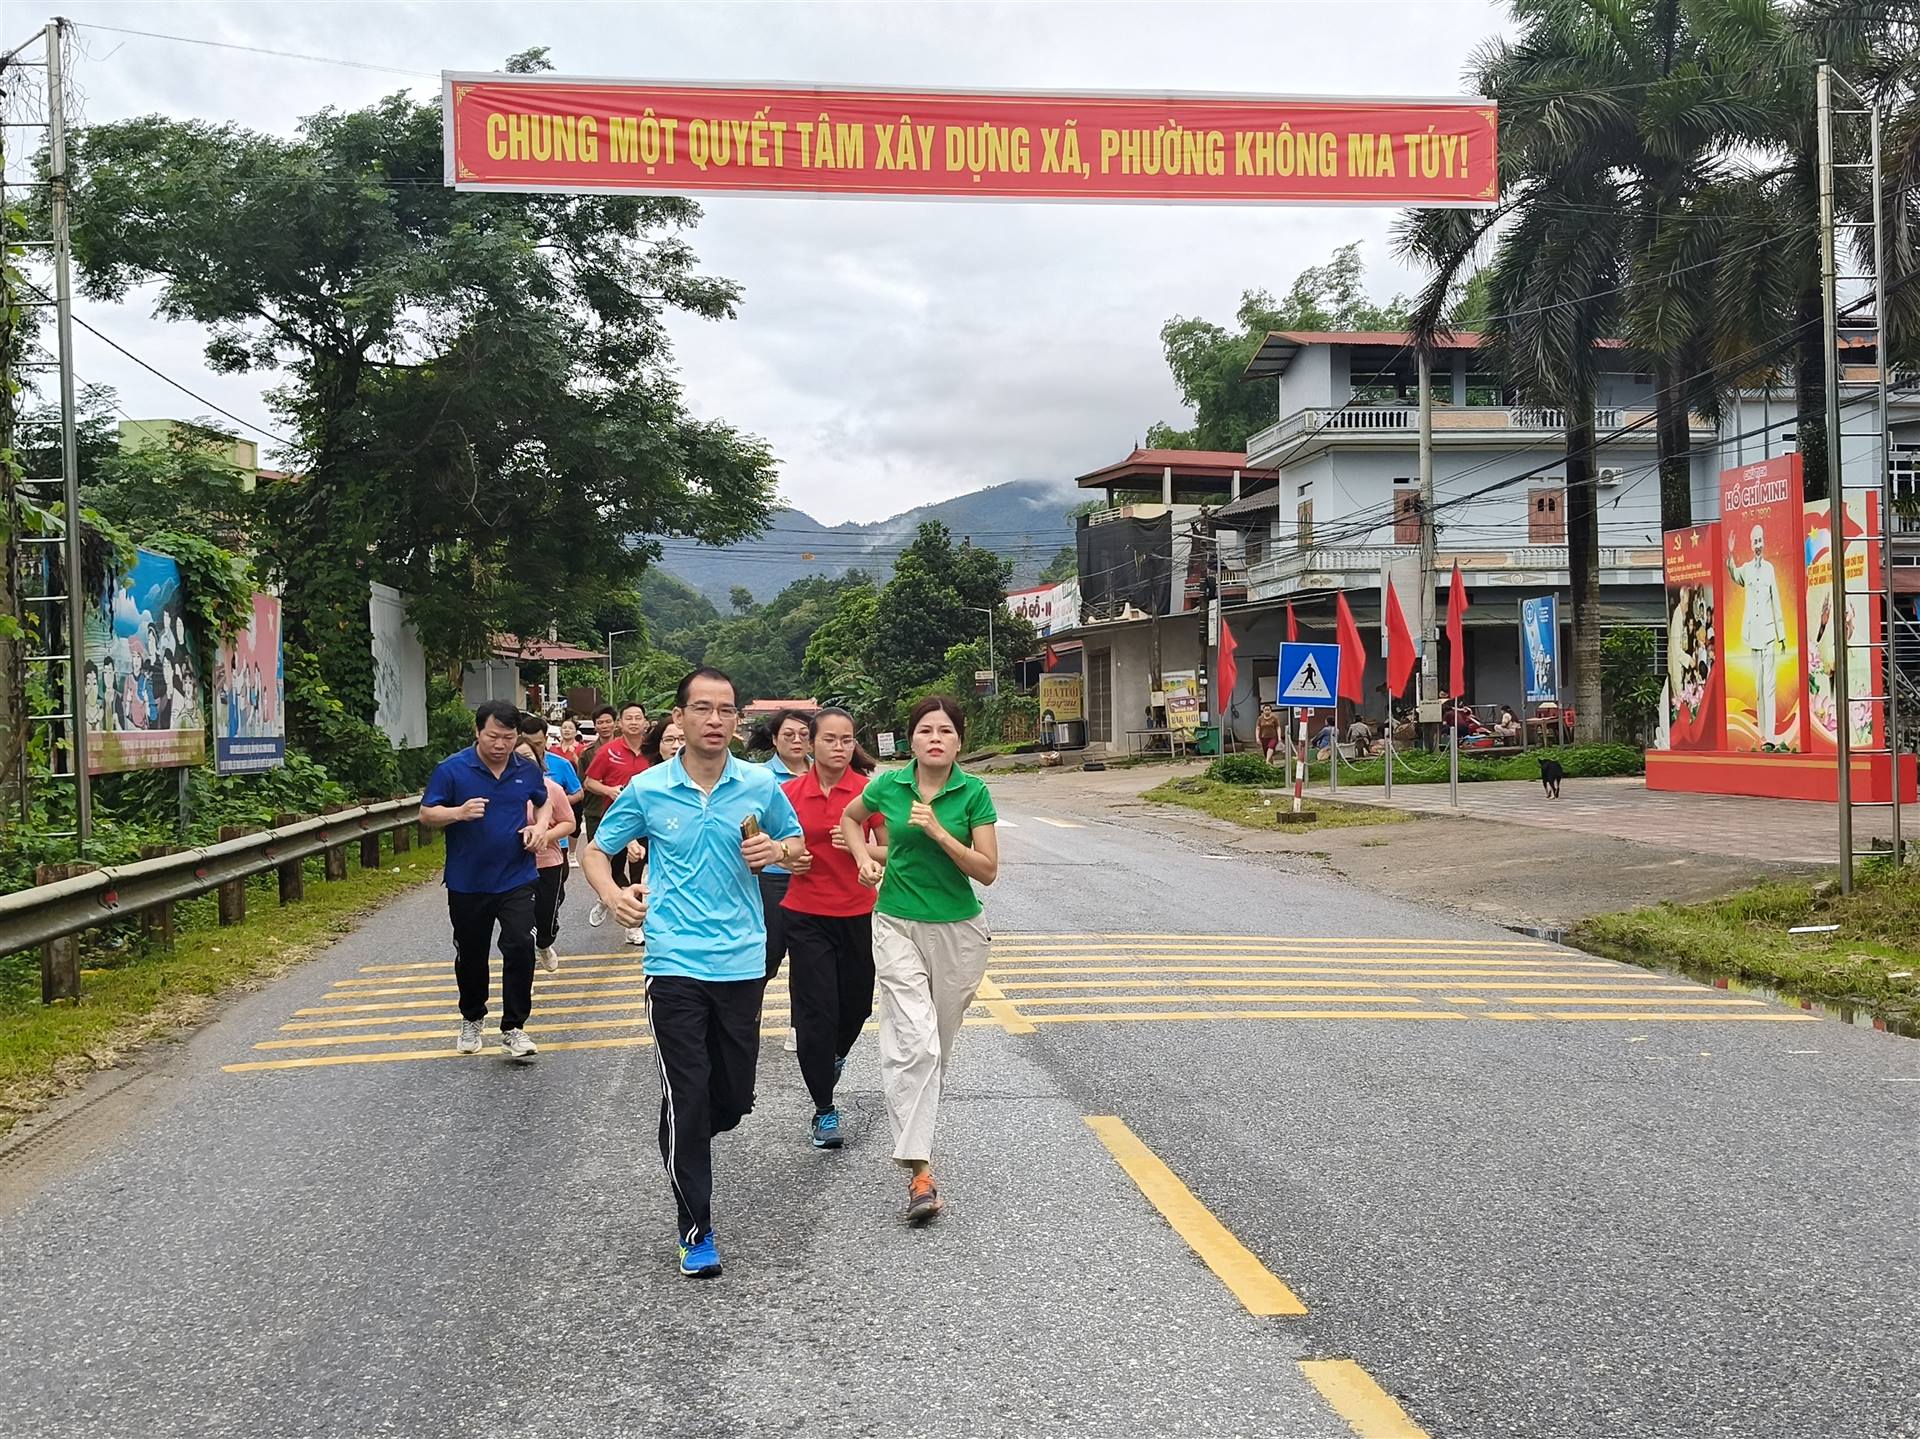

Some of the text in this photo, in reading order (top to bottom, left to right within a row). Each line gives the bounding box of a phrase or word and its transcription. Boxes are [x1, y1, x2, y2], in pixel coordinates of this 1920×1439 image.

[488, 106, 1468, 181] CHUNG MỘT QUYẾT TÂM XÂY DỰNG XÃ, PHƯỜNG KHÔNG MA TÚY!
[1742, 480, 1760, 507] CHÍ
[1761, 478, 1788, 504] MINH
